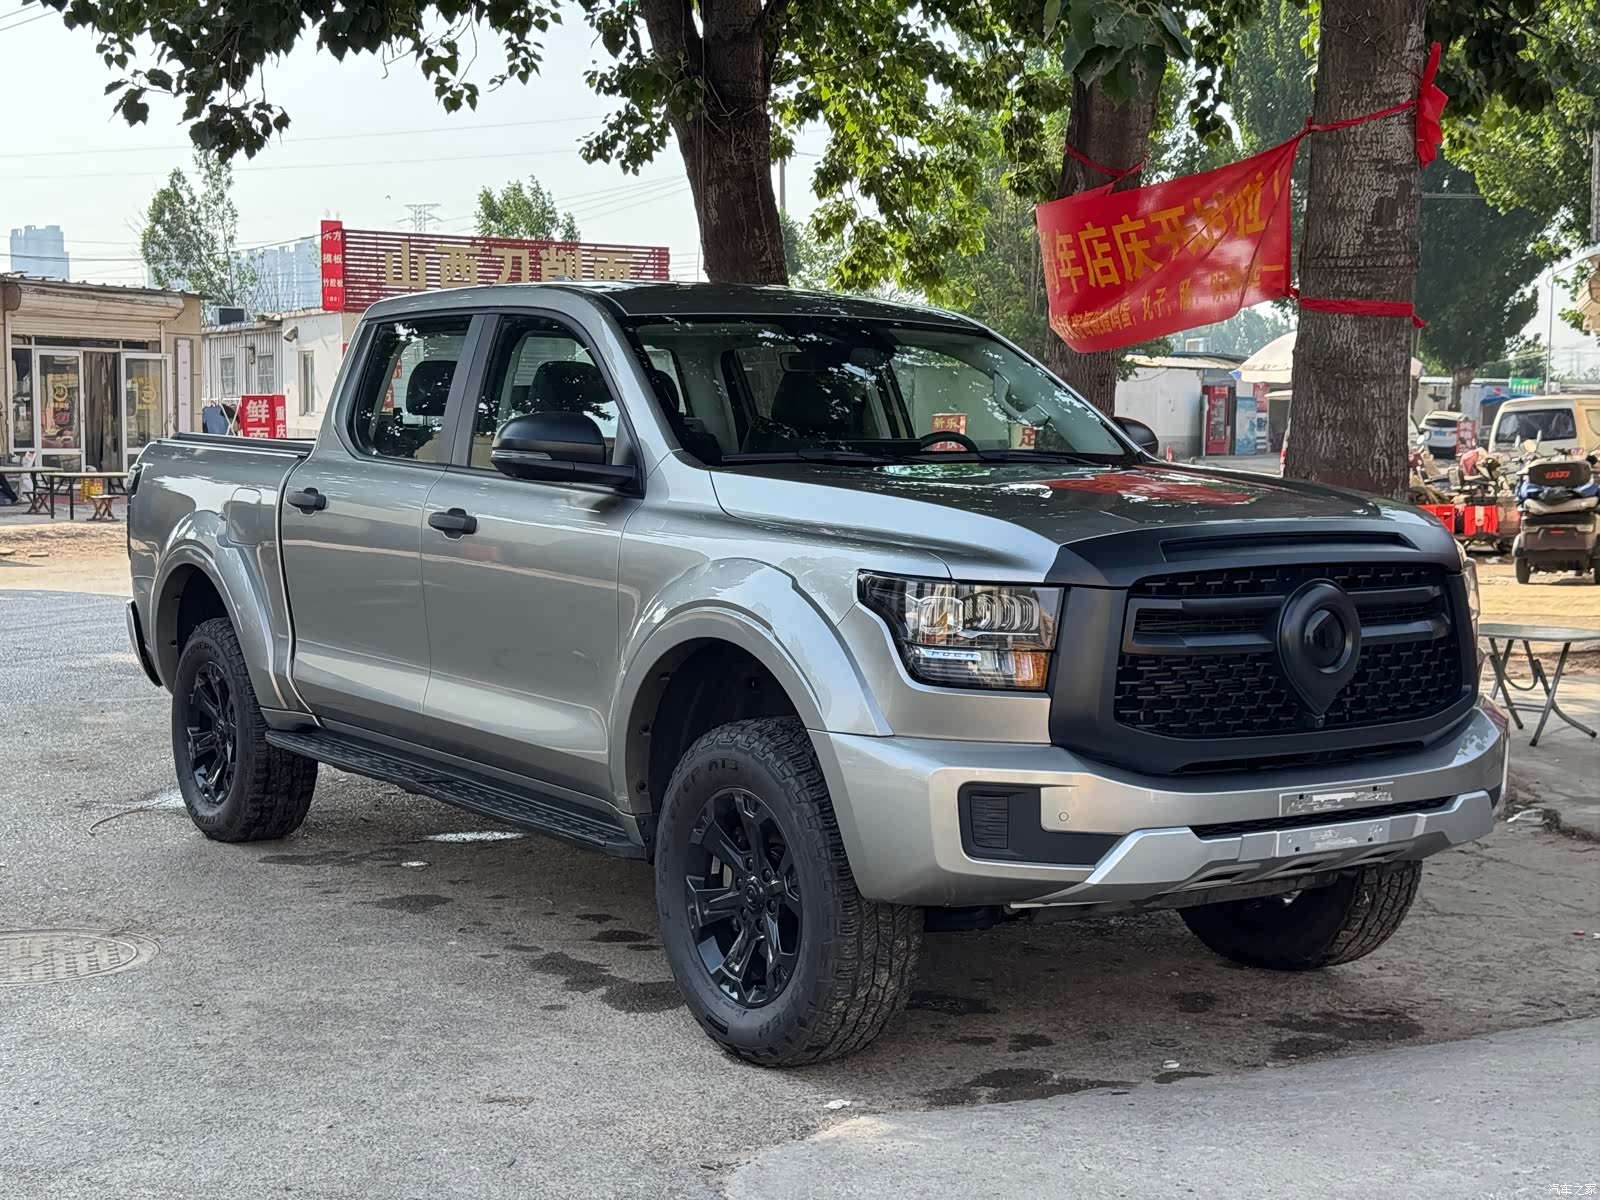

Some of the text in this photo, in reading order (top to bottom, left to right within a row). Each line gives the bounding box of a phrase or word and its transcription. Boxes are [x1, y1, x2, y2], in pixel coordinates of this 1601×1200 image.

[323, 253, 343, 264] 模板
[385, 241, 634, 289] 山西刀削面
